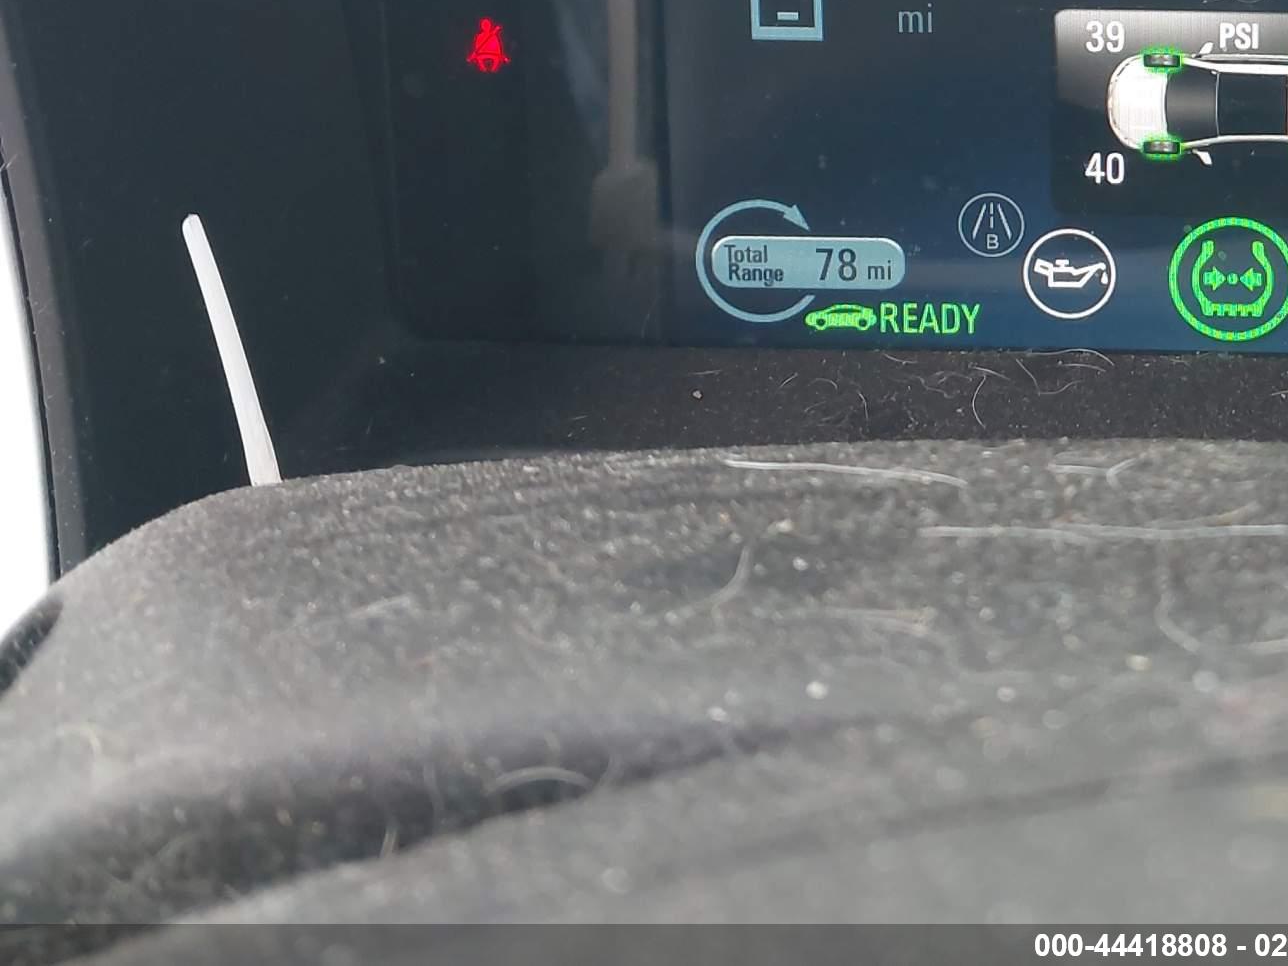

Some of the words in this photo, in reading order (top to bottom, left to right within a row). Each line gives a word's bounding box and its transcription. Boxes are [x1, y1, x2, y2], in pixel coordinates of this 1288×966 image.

[898, 3, 933, 33] mi
[1085, 21, 1125, 52] 39
[1219, 22, 1259, 49] PSI
[1085, 153, 1125, 184] 40
[724, 245, 768, 263] Total
[986, 233, 1000, 250] B
[729, 264, 784, 286] Range
[815, 248, 857, 281] 78
[867, 260, 892, 280] mi
[880, 302, 981, 334] READY
